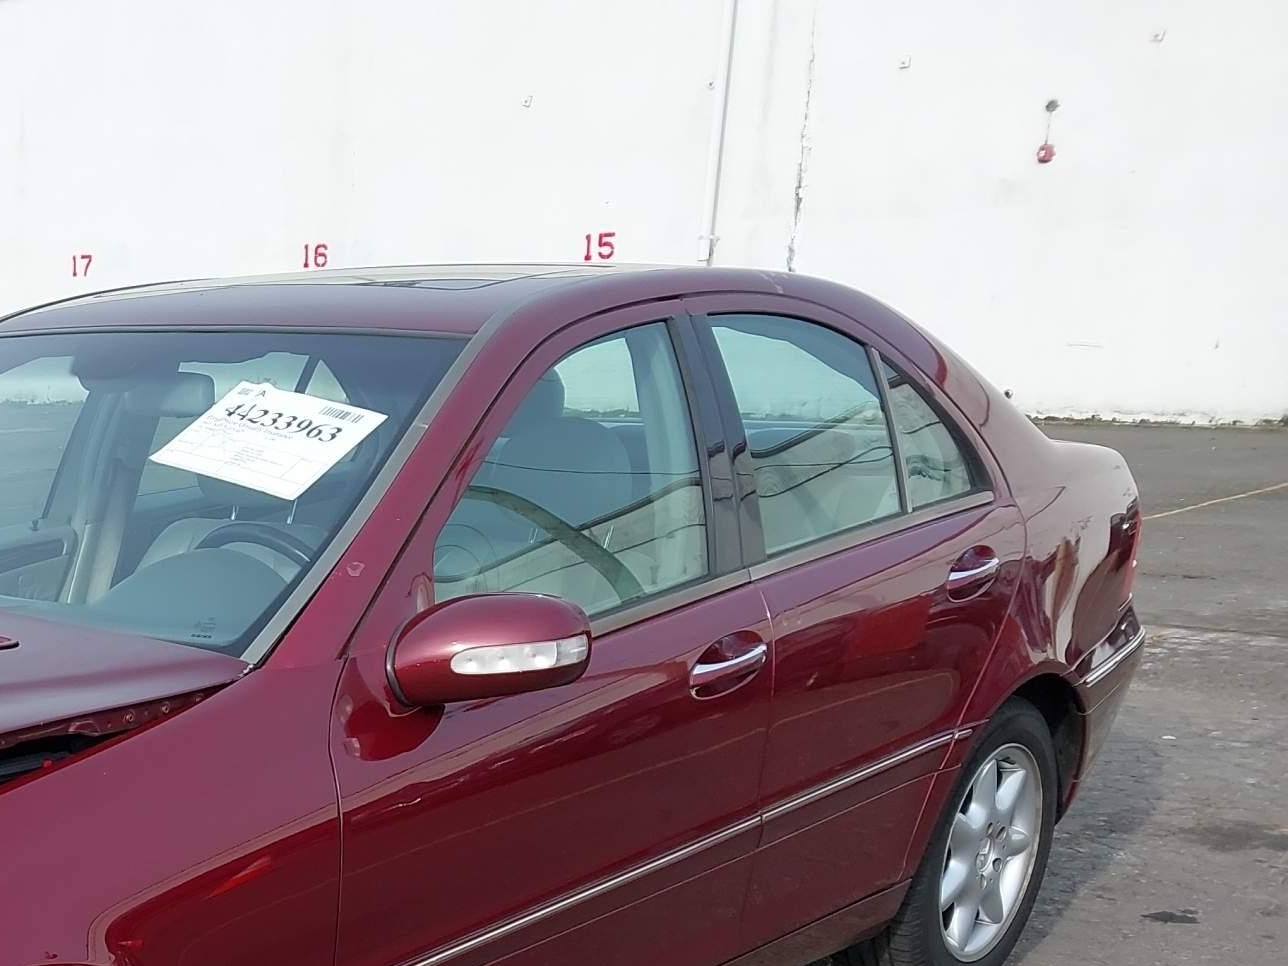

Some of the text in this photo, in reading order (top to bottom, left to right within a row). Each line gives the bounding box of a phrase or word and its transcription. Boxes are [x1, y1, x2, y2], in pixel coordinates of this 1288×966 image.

[302, 243, 329, 269] 16
[583, 231, 617, 262] 15
[72, 254, 94, 278] 17
[224, 403, 343, 442] 44233963
